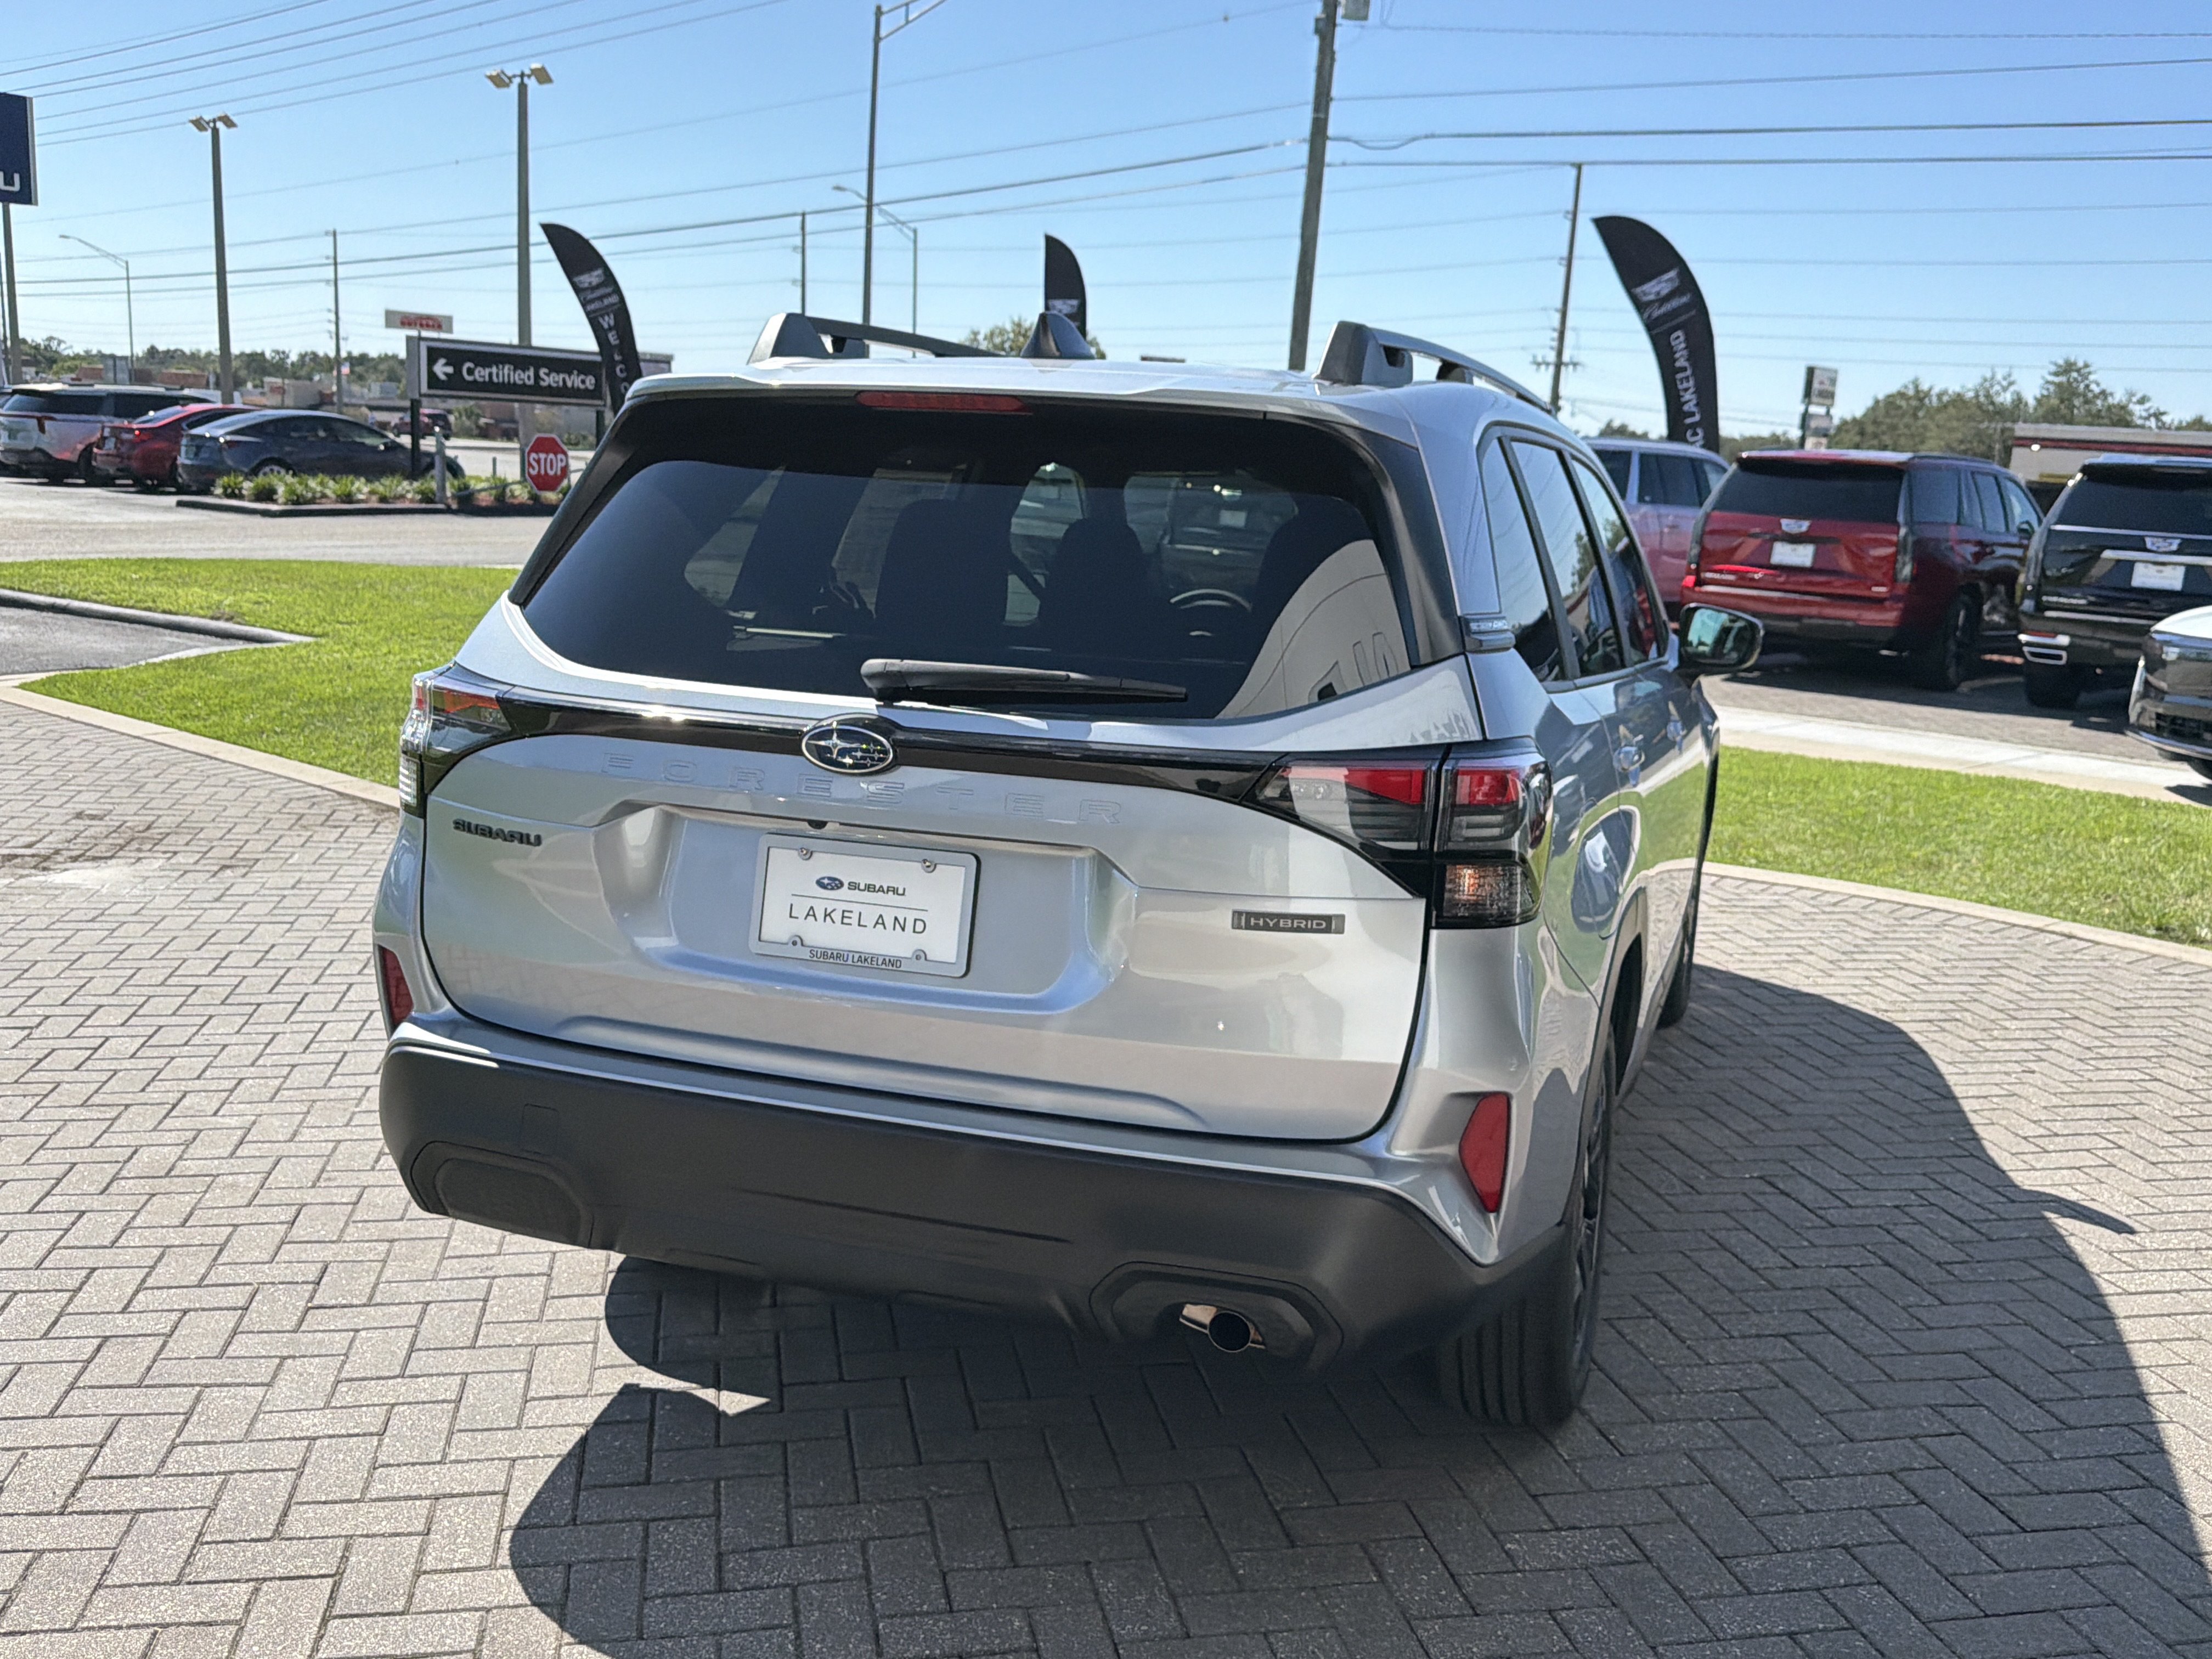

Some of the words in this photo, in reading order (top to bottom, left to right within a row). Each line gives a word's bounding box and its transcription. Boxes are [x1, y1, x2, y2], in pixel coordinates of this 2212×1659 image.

[462, 361, 534, 385] Certified
[539, 367, 596, 390] Service
[1669, 329, 1702, 425] LAKELAND
[528, 452, 567, 476] STOP
[601, 752, 1122, 824] FORESTER
[453, 817, 542, 847] SUBARU
[847, 881, 906, 896] SUBARU
[788, 902, 927, 934] LAKELAND
[1250, 917, 1326, 929] HYBRID
[808, 949, 850, 962] SUBARU
[851, 953, 902, 969] LAKELAND
